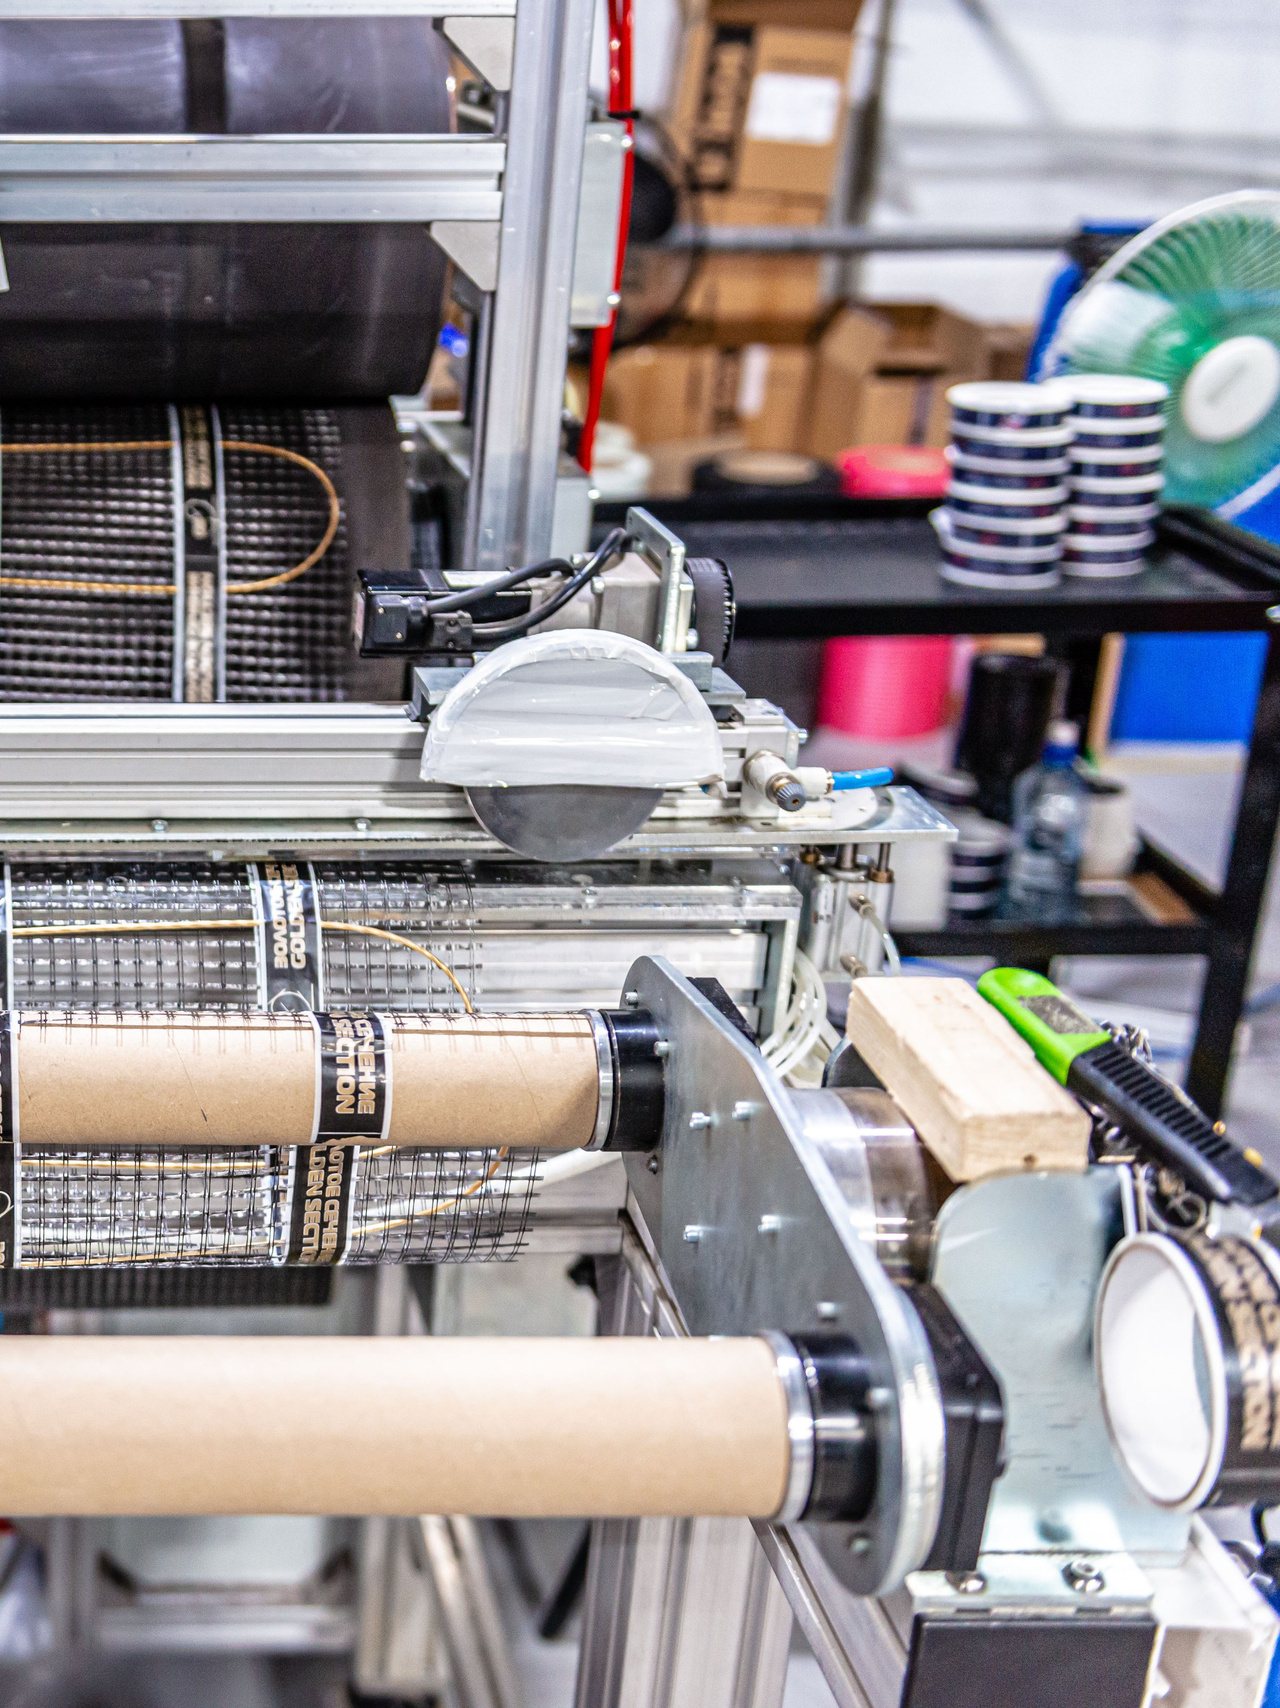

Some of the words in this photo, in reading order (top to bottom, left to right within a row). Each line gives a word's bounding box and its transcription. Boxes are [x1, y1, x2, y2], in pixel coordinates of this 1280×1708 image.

[331, 1019, 355, 1114] SECTION
[354, 1019, 376, 1114] СЕЧЕНИЕ
[306, 1145, 327, 1196] LDEN
[300, 1199, 322, 1262] SECTIO
